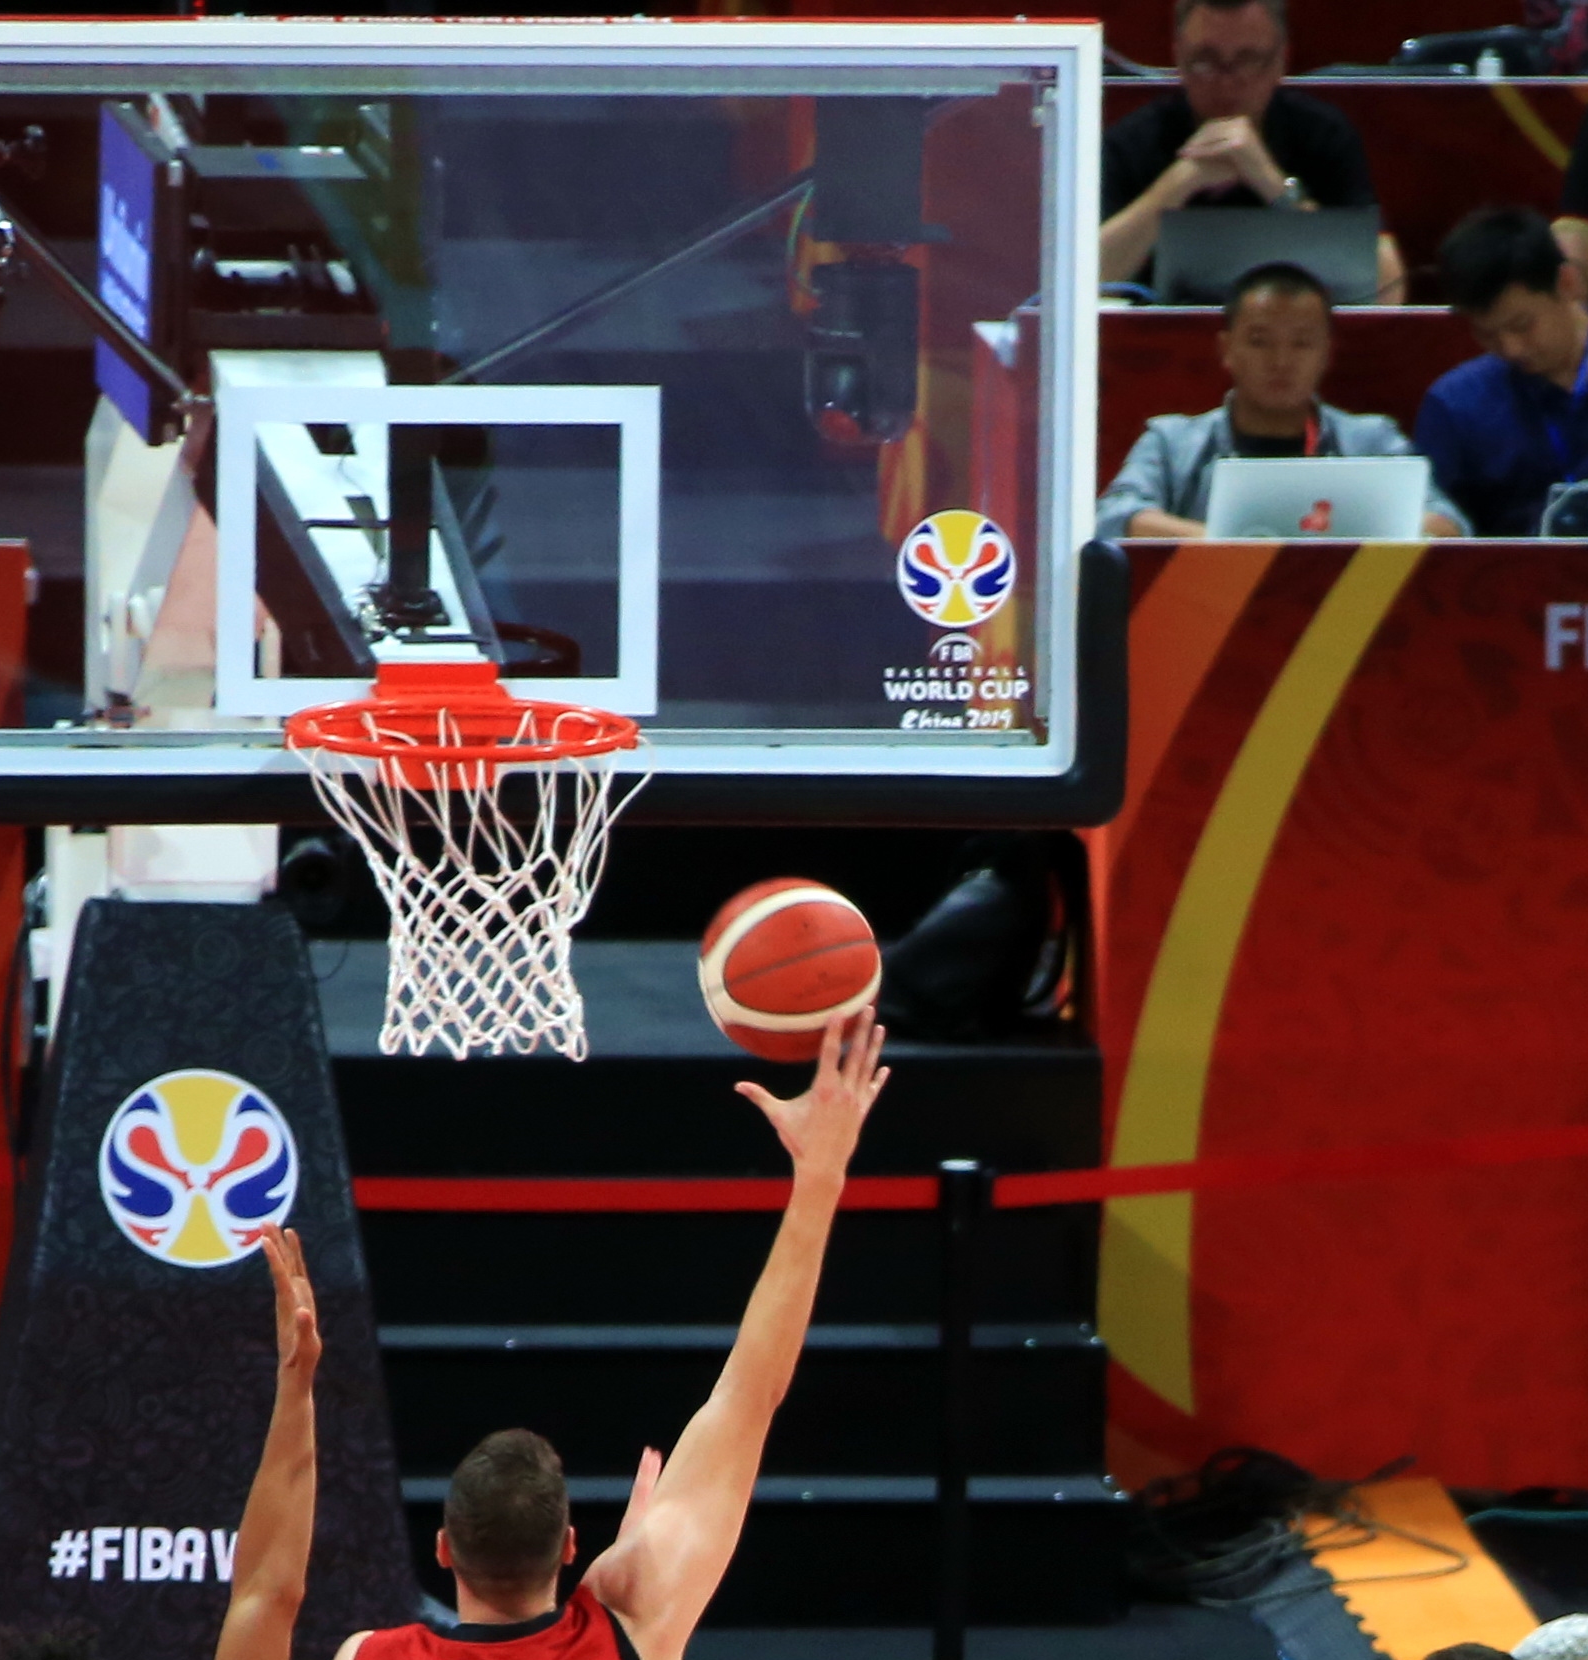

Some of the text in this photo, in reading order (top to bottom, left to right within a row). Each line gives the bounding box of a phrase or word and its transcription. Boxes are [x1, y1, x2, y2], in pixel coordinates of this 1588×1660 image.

[883, 666, 1027, 679] BASKETBALL
[882, 680, 1031, 701] WORLD CUP
[965, 709, 1013, 731] 2019
